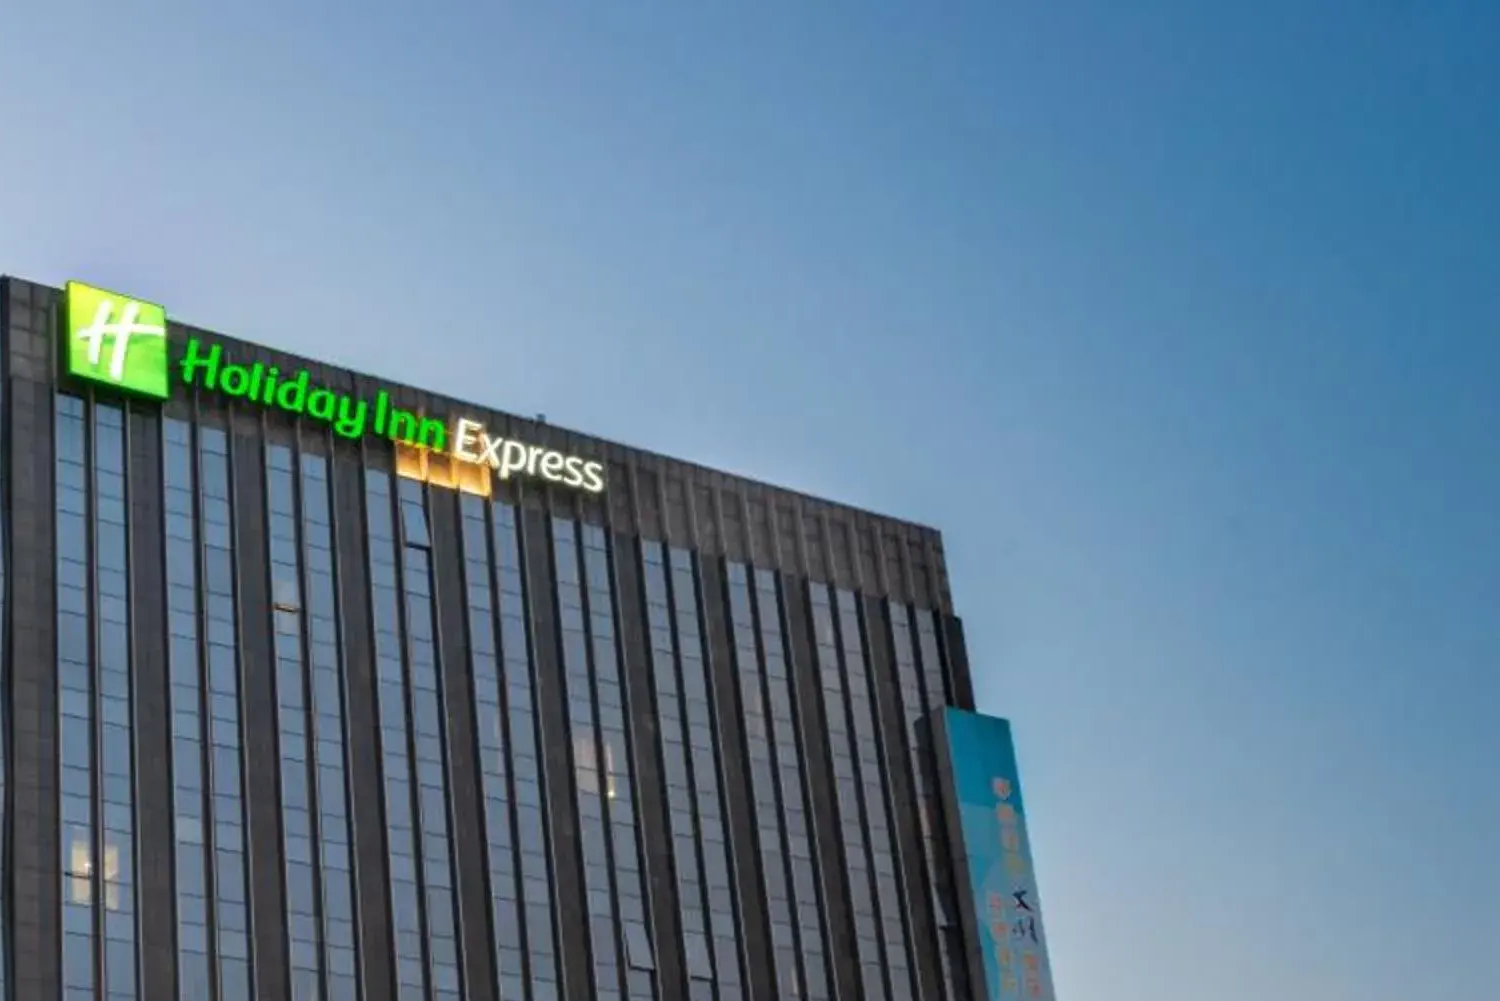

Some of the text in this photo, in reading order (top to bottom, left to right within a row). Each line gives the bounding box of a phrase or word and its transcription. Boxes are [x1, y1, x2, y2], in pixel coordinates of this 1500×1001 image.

[181, 338, 605, 495] Holiday Inn Express
